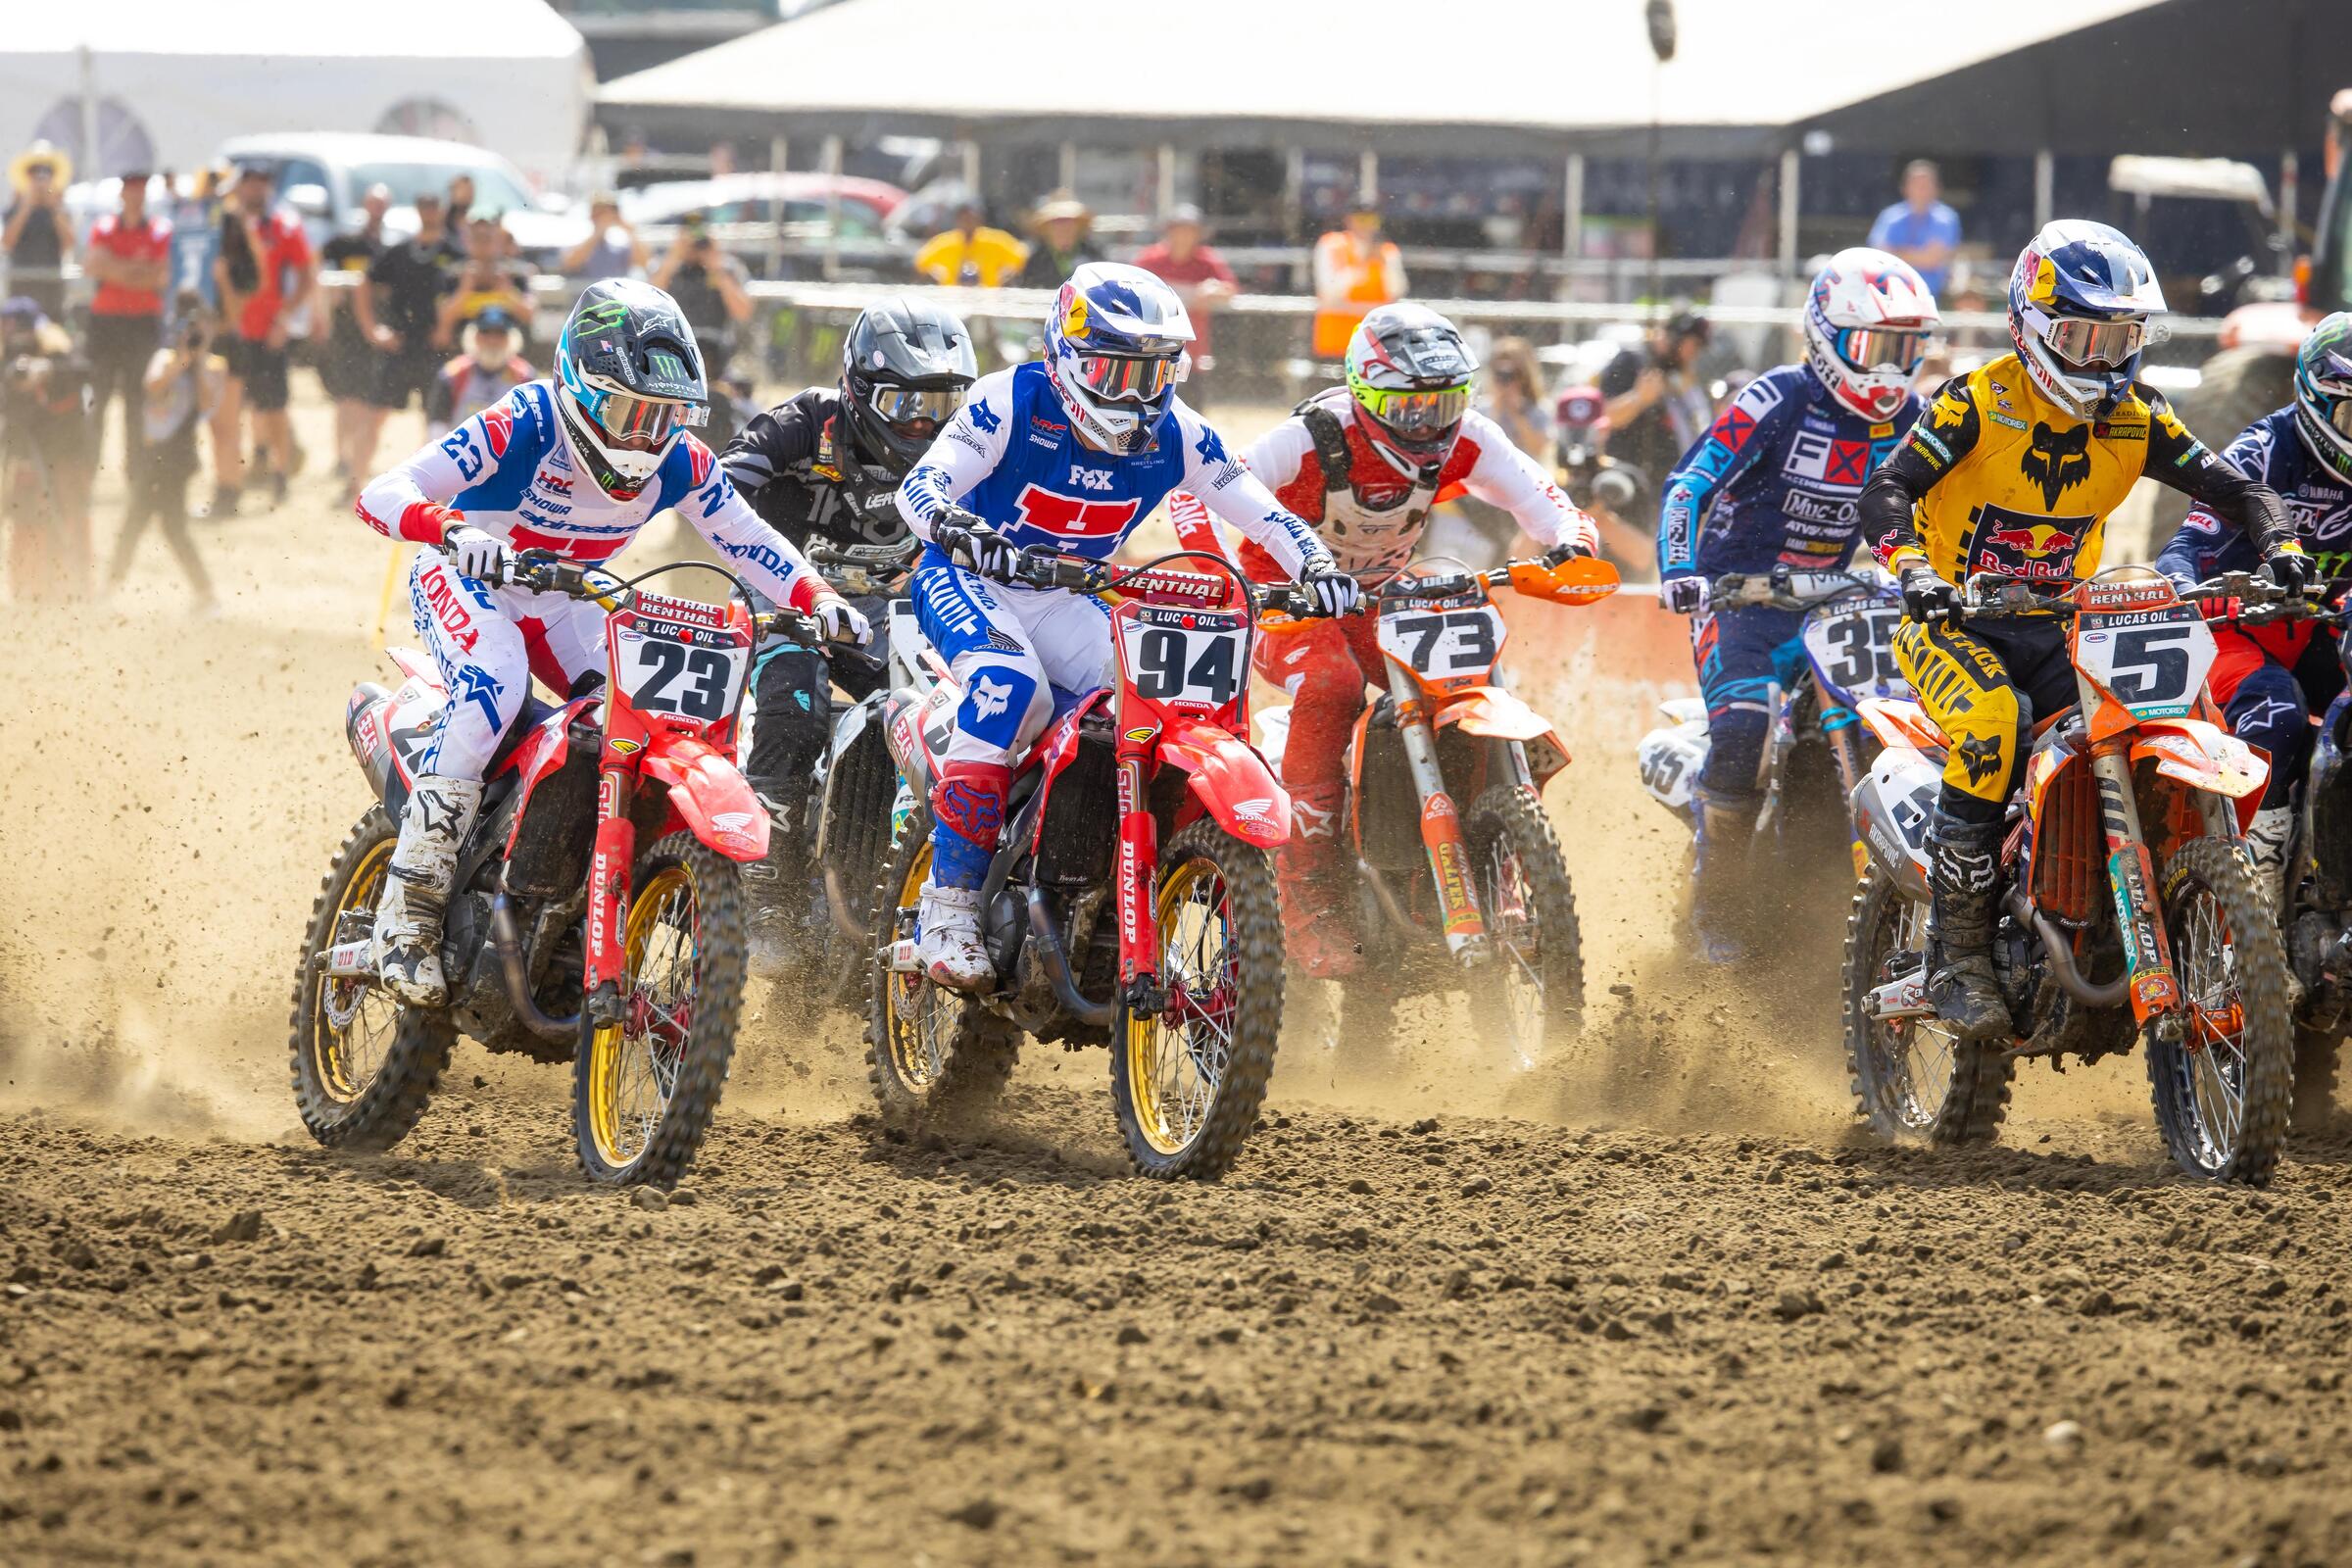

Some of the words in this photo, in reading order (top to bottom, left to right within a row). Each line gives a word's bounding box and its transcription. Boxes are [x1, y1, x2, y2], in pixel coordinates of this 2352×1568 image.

[1996, 413, 2027, 430] MOTOREX
[441, 427, 483, 482] 23
[1029, 434, 1058, 451] SHOWA
[1918, 426, 1953, 463] MOTOREX
[1068, 465, 1114, 490] FOX
[520, 488, 572, 515] SHOWA
[1789, 493, 1860, 523] Muc-O
[518, 509, 644, 534] alpinestars
[1981, 549, 2032, 577] Red
[1116, 574, 1224, 598] RENTHAL
[2090, 590, 2169, 605] RENTHAL
[640, 591, 720, 615] RENTHAL
[640, 602, 719, 627] RENTHAL
[1443, 599, 1459, 608] OIL
[1834, 601, 1868, 615] LUCAS
[1198, 615, 1217, 627] OIL
[2109, 612, 2147, 627] LUCAS
[2150, 612, 2170, 623] OIL
[696, 630, 714, 644] OIL
[1395, 612, 1496, 673] 73
[1137, 629, 1237, 705] 94
[2109, 627, 2191, 705] 5
[632, 640, 731, 722] 23
[1174, 701, 1210, 710] HONDA
[2148, 707, 2186, 715] MOTOREX
[663, 713, 700, 725] HONDA
[1641, 741, 1693, 796] 35
[1235, 814, 1279, 828] HONDA
[712, 825, 759, 844] HONDA
[591, 852, 607, 956] DUNLOP
[1122, 840, 1137, 944] DUNLOP
[2114, 891, 2138, 963] MOTOREX
[2133, 966, 2171, 982] ACERBIS
